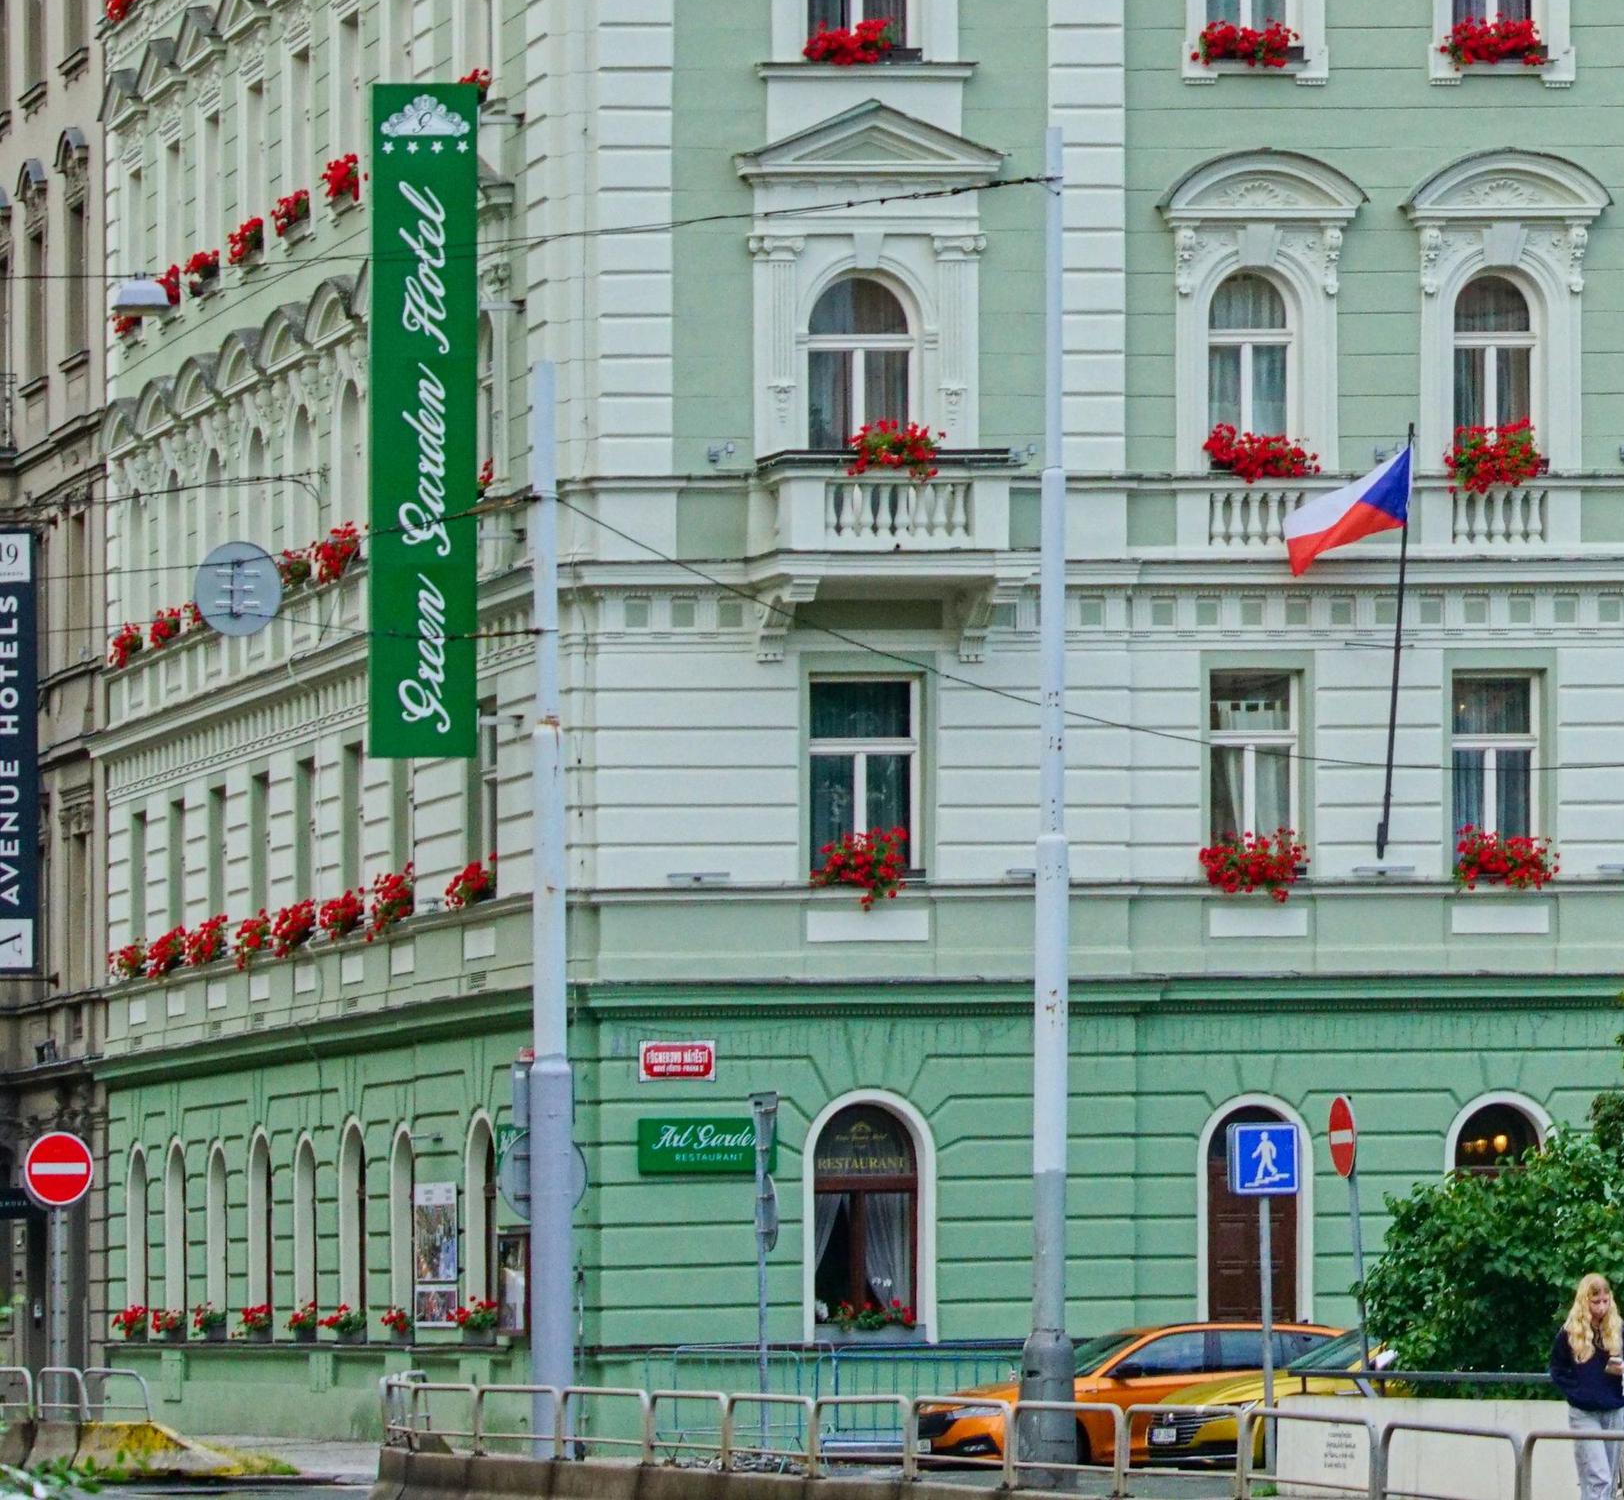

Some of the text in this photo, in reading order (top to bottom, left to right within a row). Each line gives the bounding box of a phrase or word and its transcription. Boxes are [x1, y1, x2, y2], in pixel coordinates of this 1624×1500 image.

[399, 181, 450, 733] Green Garden Hotel
[0, 595, 19, 735] HOTELS
[0, 759, 19, 906] AVENUE
[652, 1125, 694, 1150] Art
[674, 1153, 743, 1162] RESTAURANT
[818, 1157, 904, 1170] RESTAURANT
